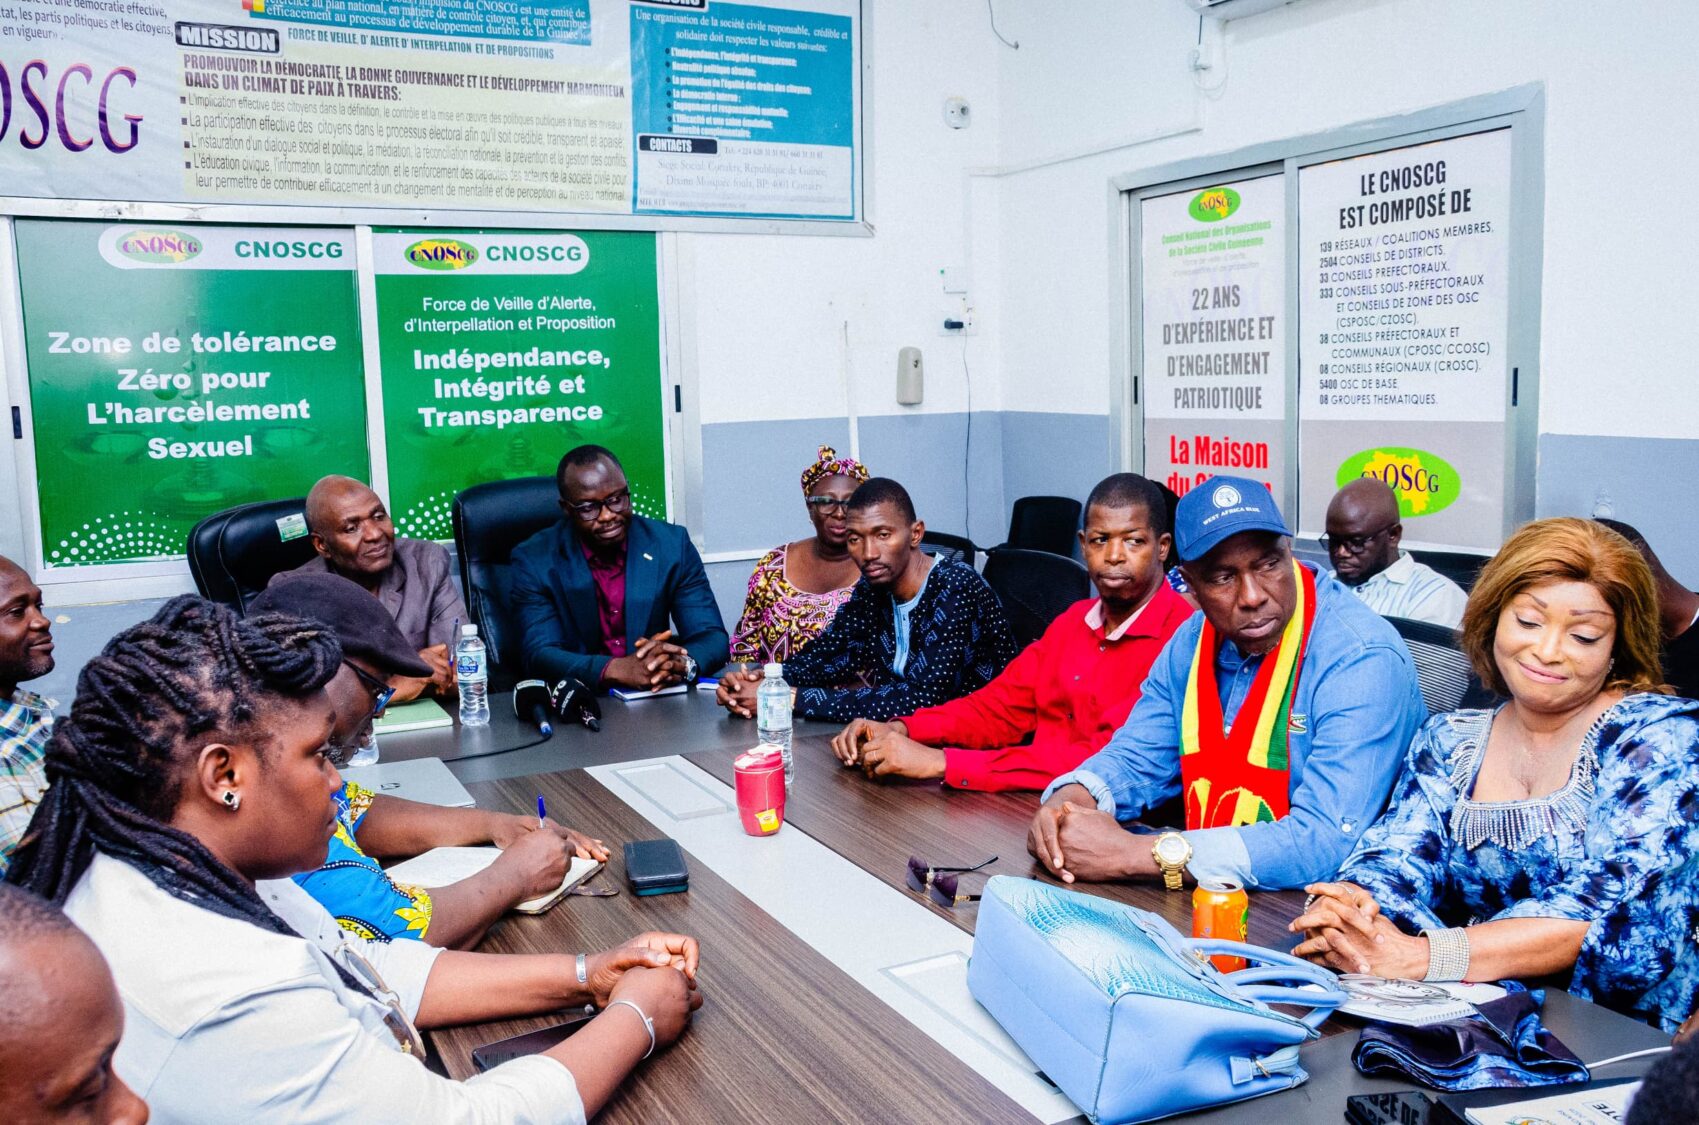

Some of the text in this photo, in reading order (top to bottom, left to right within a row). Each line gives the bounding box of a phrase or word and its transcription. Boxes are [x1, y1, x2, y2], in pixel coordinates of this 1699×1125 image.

[126, 4, 167, 19] effective,
[267, 4, 545, 37] efficacement au processus de développement durable de la
[326, 0, 587, 29] plan national, en matière de contrôle qui contribue
[476, 0, 585, 18] CNOSCG est une de
[636, 9, 766, 32] Une organisation de la civile
[3, 24, 14, 36] en
[20, 8, 173, 37] les partis politiques et les citoyens,
[181, 26, 276, 51] MISSION
[288, 28, 316, 41] FORCE
[318, 31, 328, 42] DE
[370, 35, 399, 48] ALERTE
[411, 39, 472, 53] INTERPELATION
[475, 43, 485, 54] ET
[486, 44, 497, 55] DE
[498, 45, 555, 60] PROPOSITIONS
[675, 29, 796, 50] solidaire doit respecter les valeurs
[184, 54, 625, 98] PROMOUVOIR LA DÉMOCRATIE, LA BONNE GOUVERNANCE ET LE DÉVELOPPEMENT HARMONIEUX
[185, 72, 402, 101] DANS UN CLIMAT DE PAIX À TRAVERS:
[0, 58, 143, 153] SCG
[190, 110, 353, 138] La participation effective des citoyens
[650, 137, 693, 153] CONTACTS
[216, 175, 318, 191] permettre de contribuer
[1361, 160, 1446, 196] LE CNOSCG
[1340, 187, 1472, 230] EST COMPOSÉ DE
[122, 235, 198, 255] CNOSCG
[235, 240, 343, 259] CNOSCG
[1320, 241, 1332, 253] 139
[1382, 228, 1440, 246] COALITIONS
[410, 244, 475, 262] CNOSCG
[486, 245, 582, 262] CNOSCG
[1320, 256, 1338, 269] 2504
[1339, 252, 1381, 267] CONSEILS
[1385, 249, 1396, 262] DE
[1320, 272, 1329, 284] 33
[1331, 269, 1373, 283] CONSEILS
[1192, 284, 1241, 311] 22 ANS
[1336, 284, 1378, 298] CONSEILS
[1337, 291, 1479, 313] ET CONSEILS DE ZONE DES OSC
[423, 296, 596, 312] Force de Veille d'Alerte,
[404, 316, 616, 335] d'Interpellation et Proposition
[1163, 316, 1275, 345] D'EXPÉRIENCE ET
[1331, 331, 1372, 344] CONSEILS
[1450, 326, 1460, 338] ET
[48, 331, 337, 353] Zone de tolérance
[1332, 346, 1401, 359] CCOMMUNAUX
[414, 347, 611, 373] Indépendance,
[1167, 351, 1270, 377] D'ENGAGEMENT
[1331, 362, 1372, 374] CONSEILS
[117, 368, 271, 394] Zéro pour
[435, 375, 586, 401] Intégrité et
[1320, 378, 1338, 390] 5400
[1340, 379, 1359, 390] OSC
[1361, 378, 1373, 390] DE
[1174, 386, 1262, 412] PATRIOTIQUE
[1331, 394, 1371, 406] GROUPES
[87, 399, 311, 425] L'harcèlement
[418, 404, 604, 429] Transparence
[148, 435, 253, 460] Sexuel
[1170, 434, 1268, 469] La Maison
